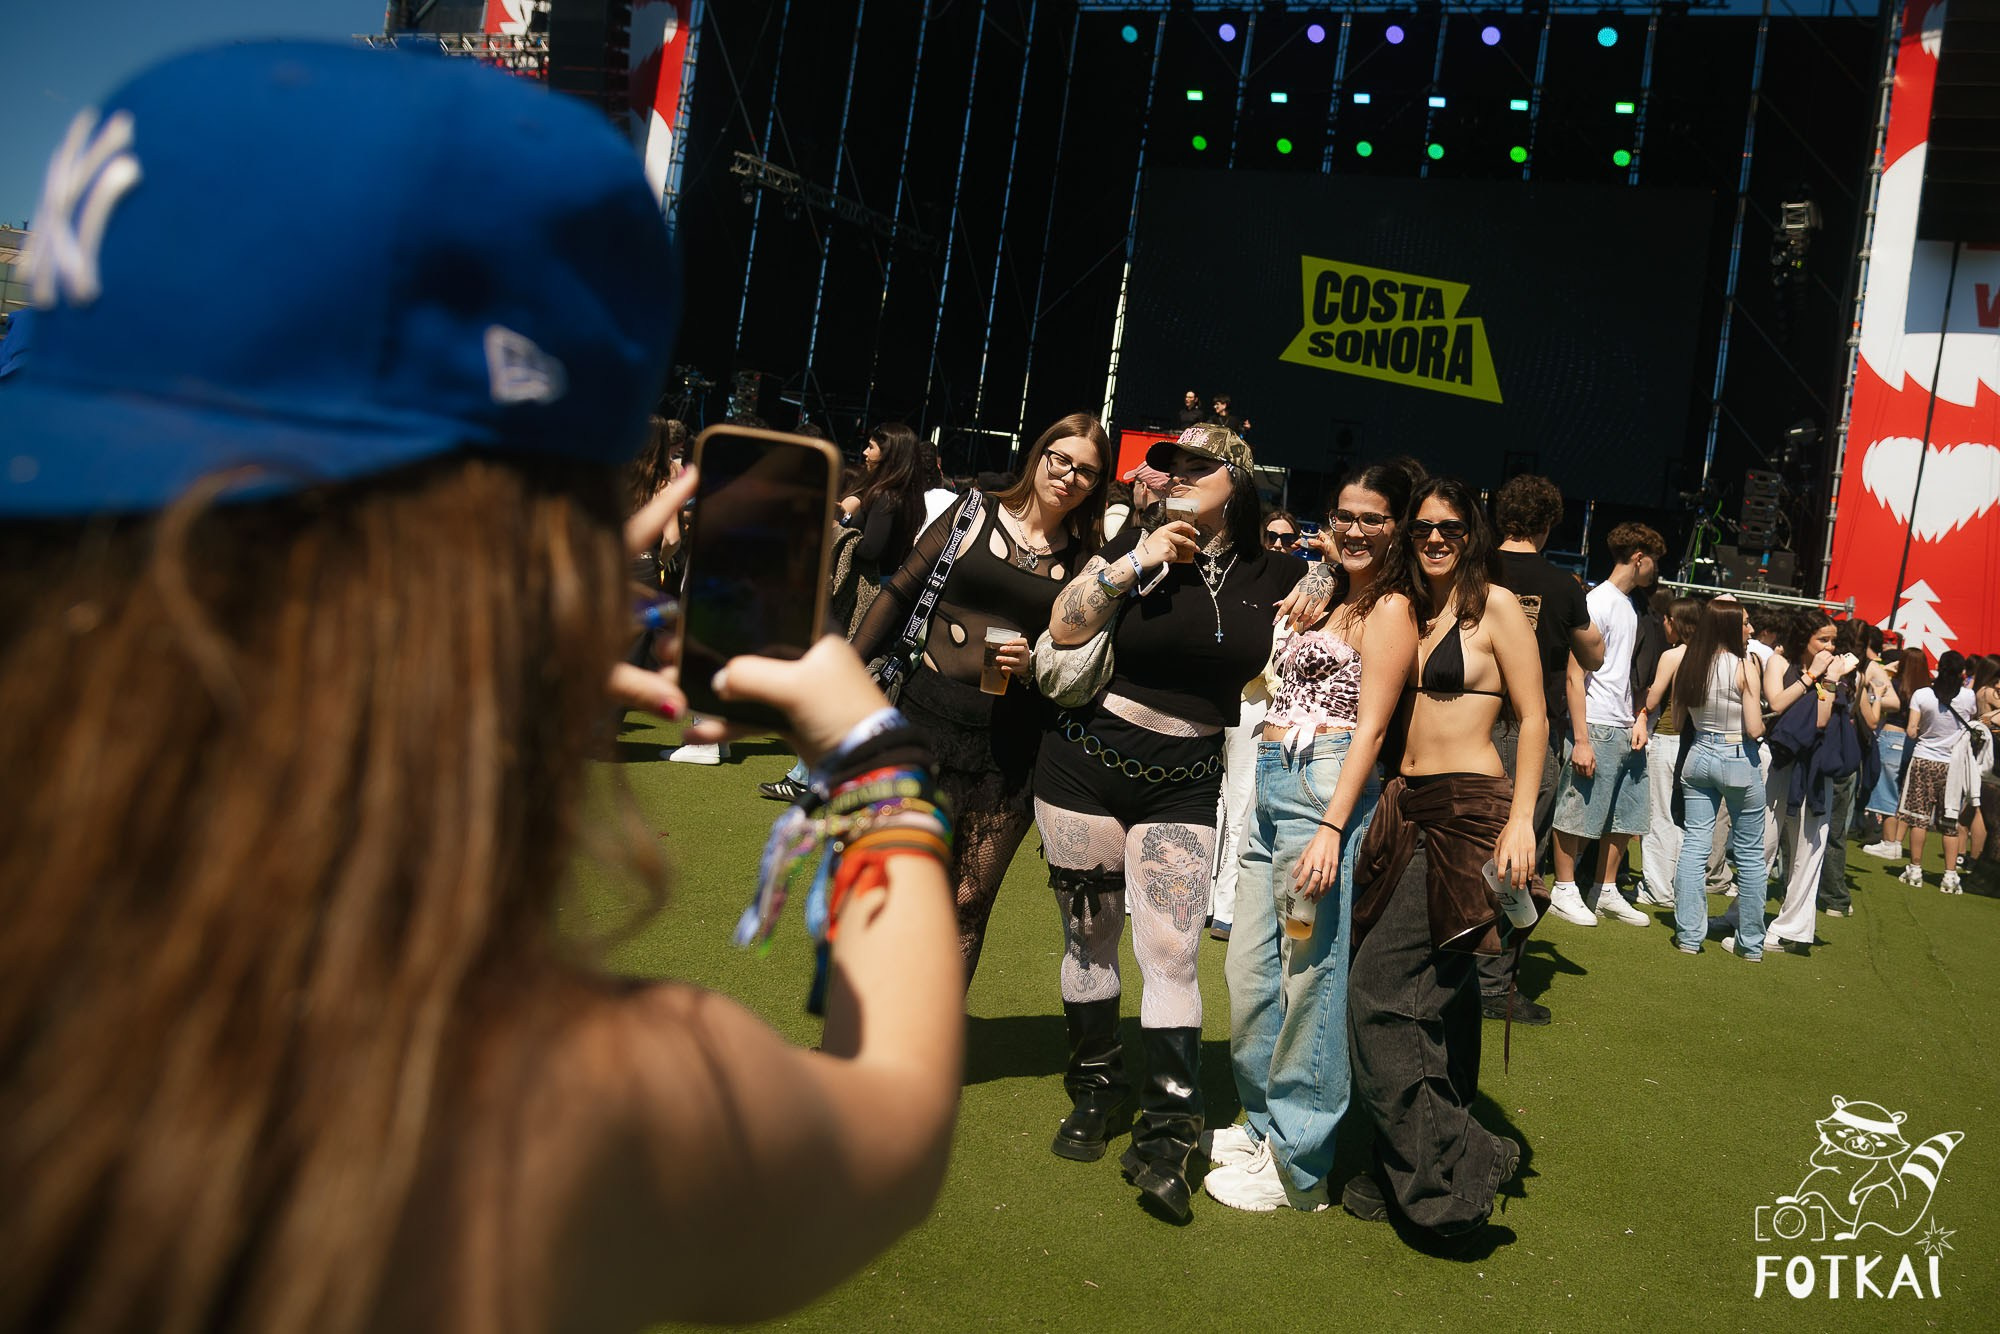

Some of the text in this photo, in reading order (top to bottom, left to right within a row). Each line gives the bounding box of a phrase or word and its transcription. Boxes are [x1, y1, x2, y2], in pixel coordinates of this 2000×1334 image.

[1312, 270, 1445, 326] COSTA
[1307, 323, 1473, 387] SONORA
[941, 527, 966, 565] HARDCORE
